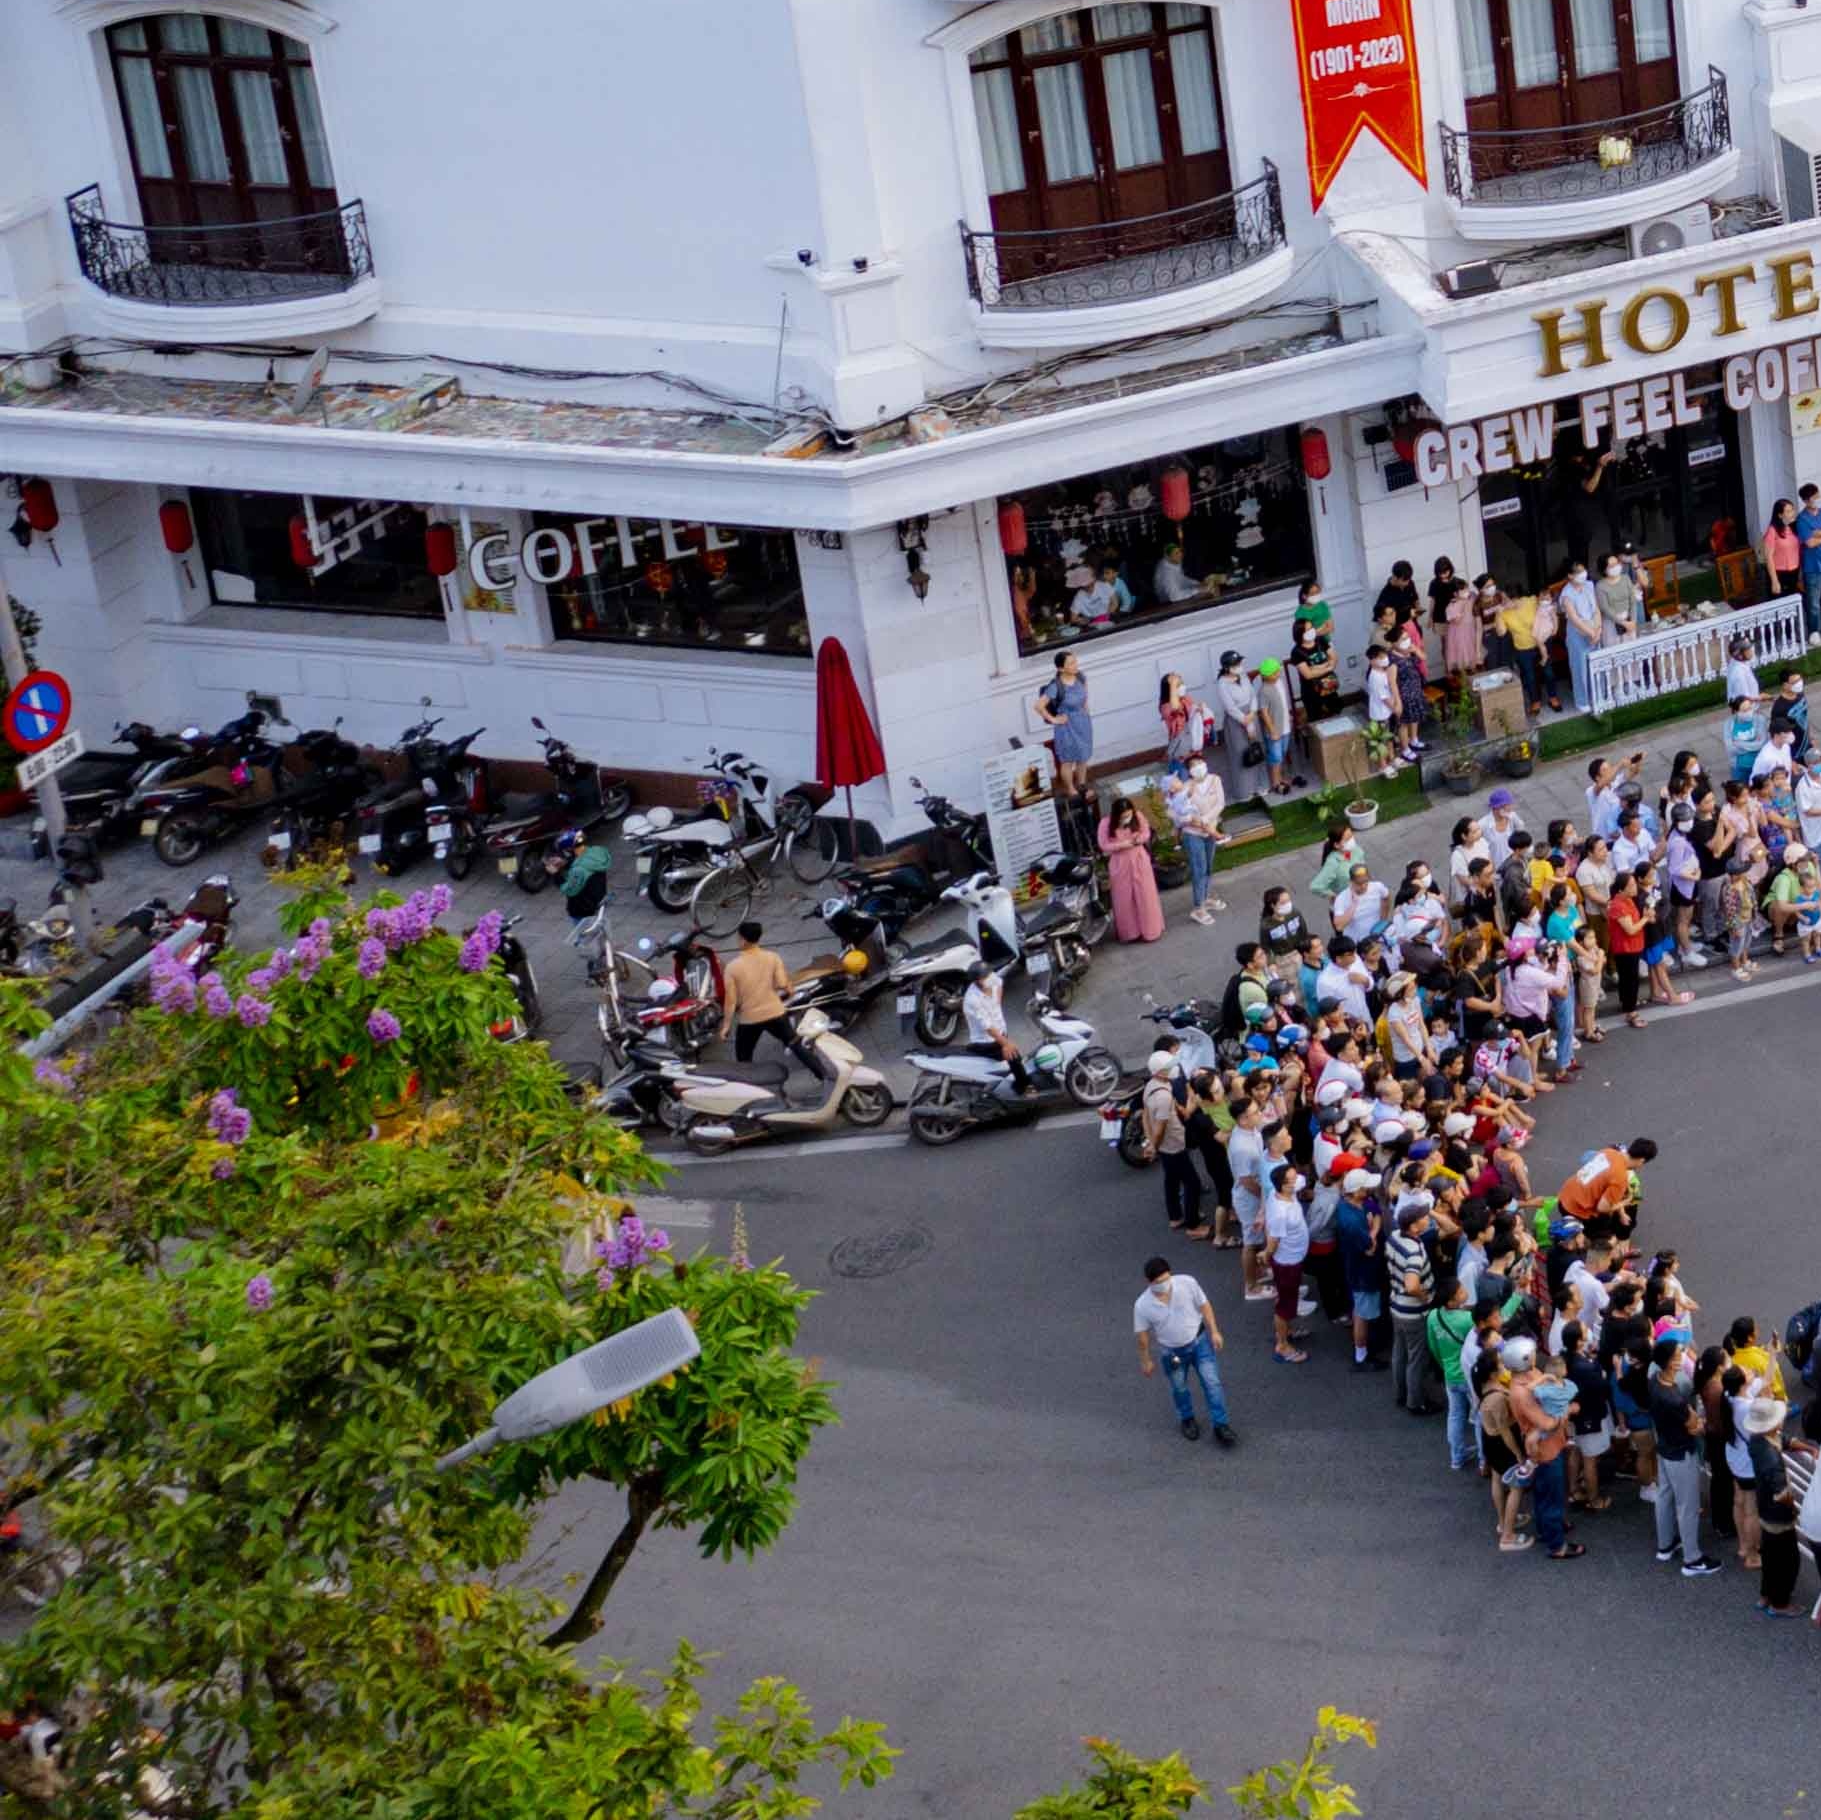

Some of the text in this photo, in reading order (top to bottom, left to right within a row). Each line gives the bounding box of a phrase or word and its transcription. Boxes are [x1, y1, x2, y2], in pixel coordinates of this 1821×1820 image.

[1310, 40, 1404, 81] (1901-2023)
[1415, 404, 1555, 488] CREW
[1580, 371, 1701, 450] FEEL
